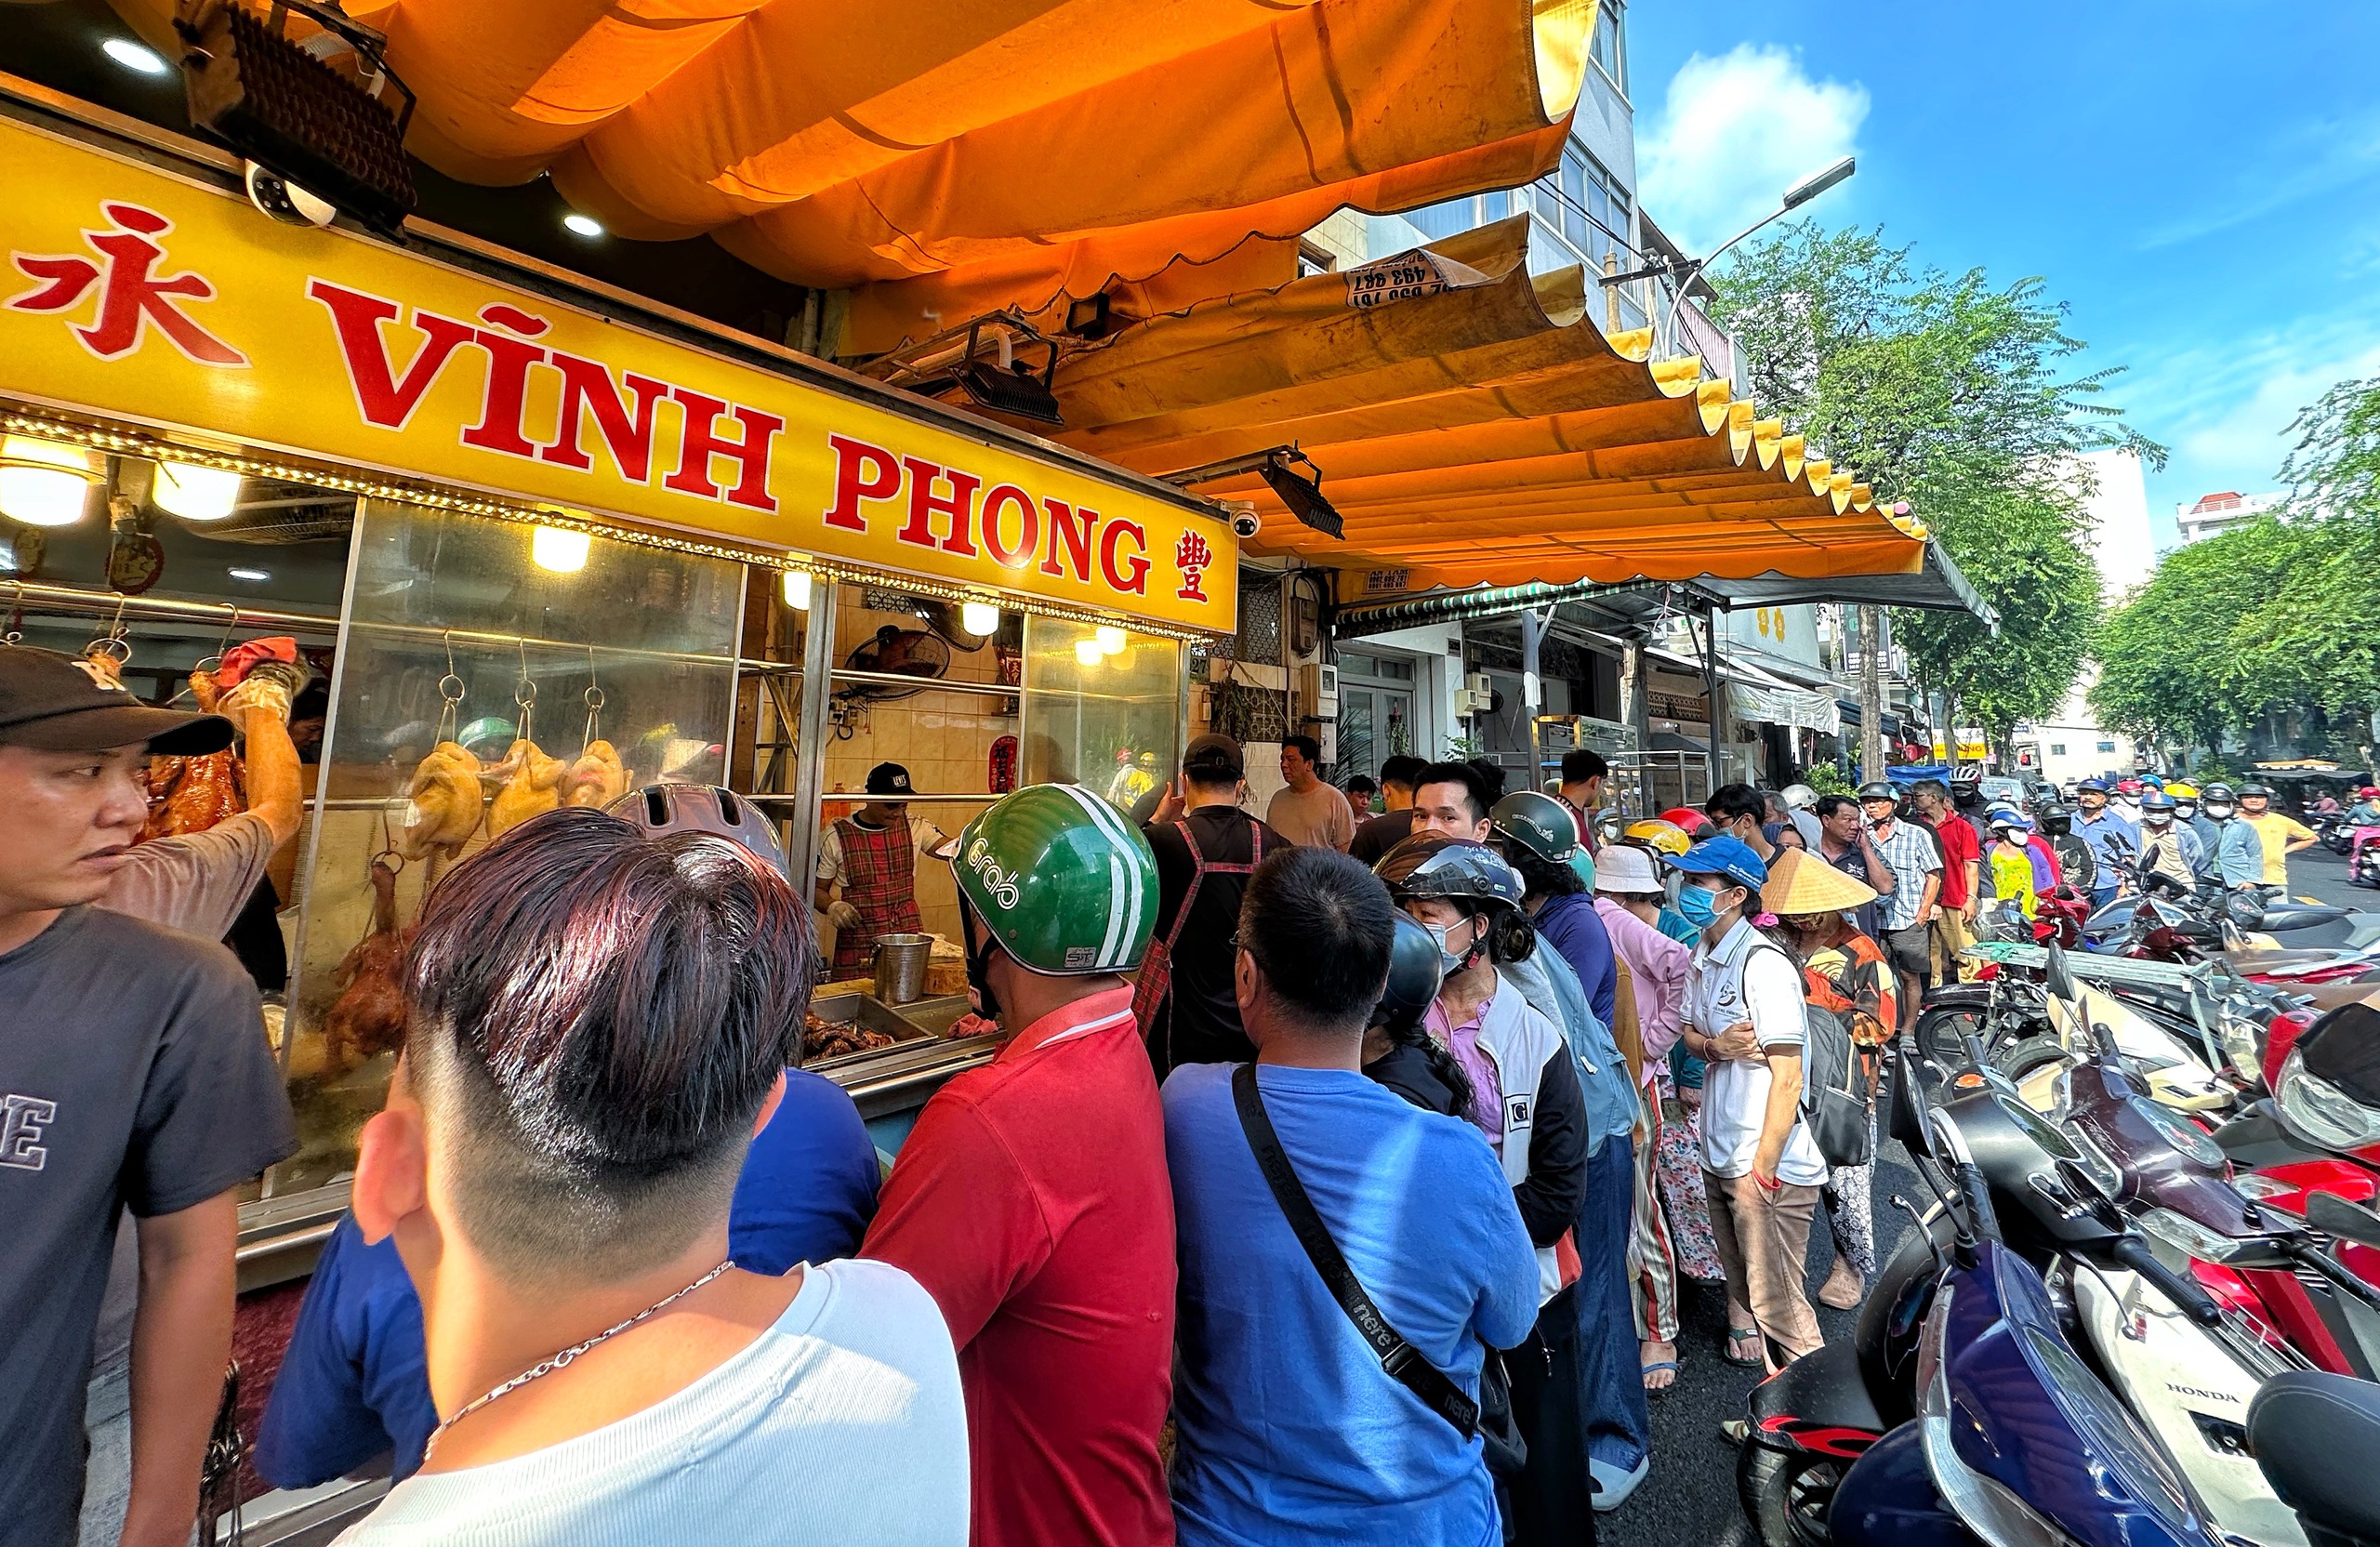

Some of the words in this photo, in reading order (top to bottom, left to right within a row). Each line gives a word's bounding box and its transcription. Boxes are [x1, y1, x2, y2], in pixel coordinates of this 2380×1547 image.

[10, 203, 247, 364] 永
[1354, 272, 1387, 292] 987
[1391, 265, 1426, 285] 493
[310, 280, 783, 512] VĨNH
[824, 433, 1151, 595] PHONG
[1175, 528, 1212, 603] 豐
[1192, 657, 1207, 674] 27
[967, 836, 1020, 911] Grab
[1513, 1103, 1527, 1122] G
[0, 1093, 58, 1171] E
[1353, 1303, 1394, 1347] nere
[1444, 1393, 1472, 1424] nere
[2165, 1382, 2241, 1405] HONDA
